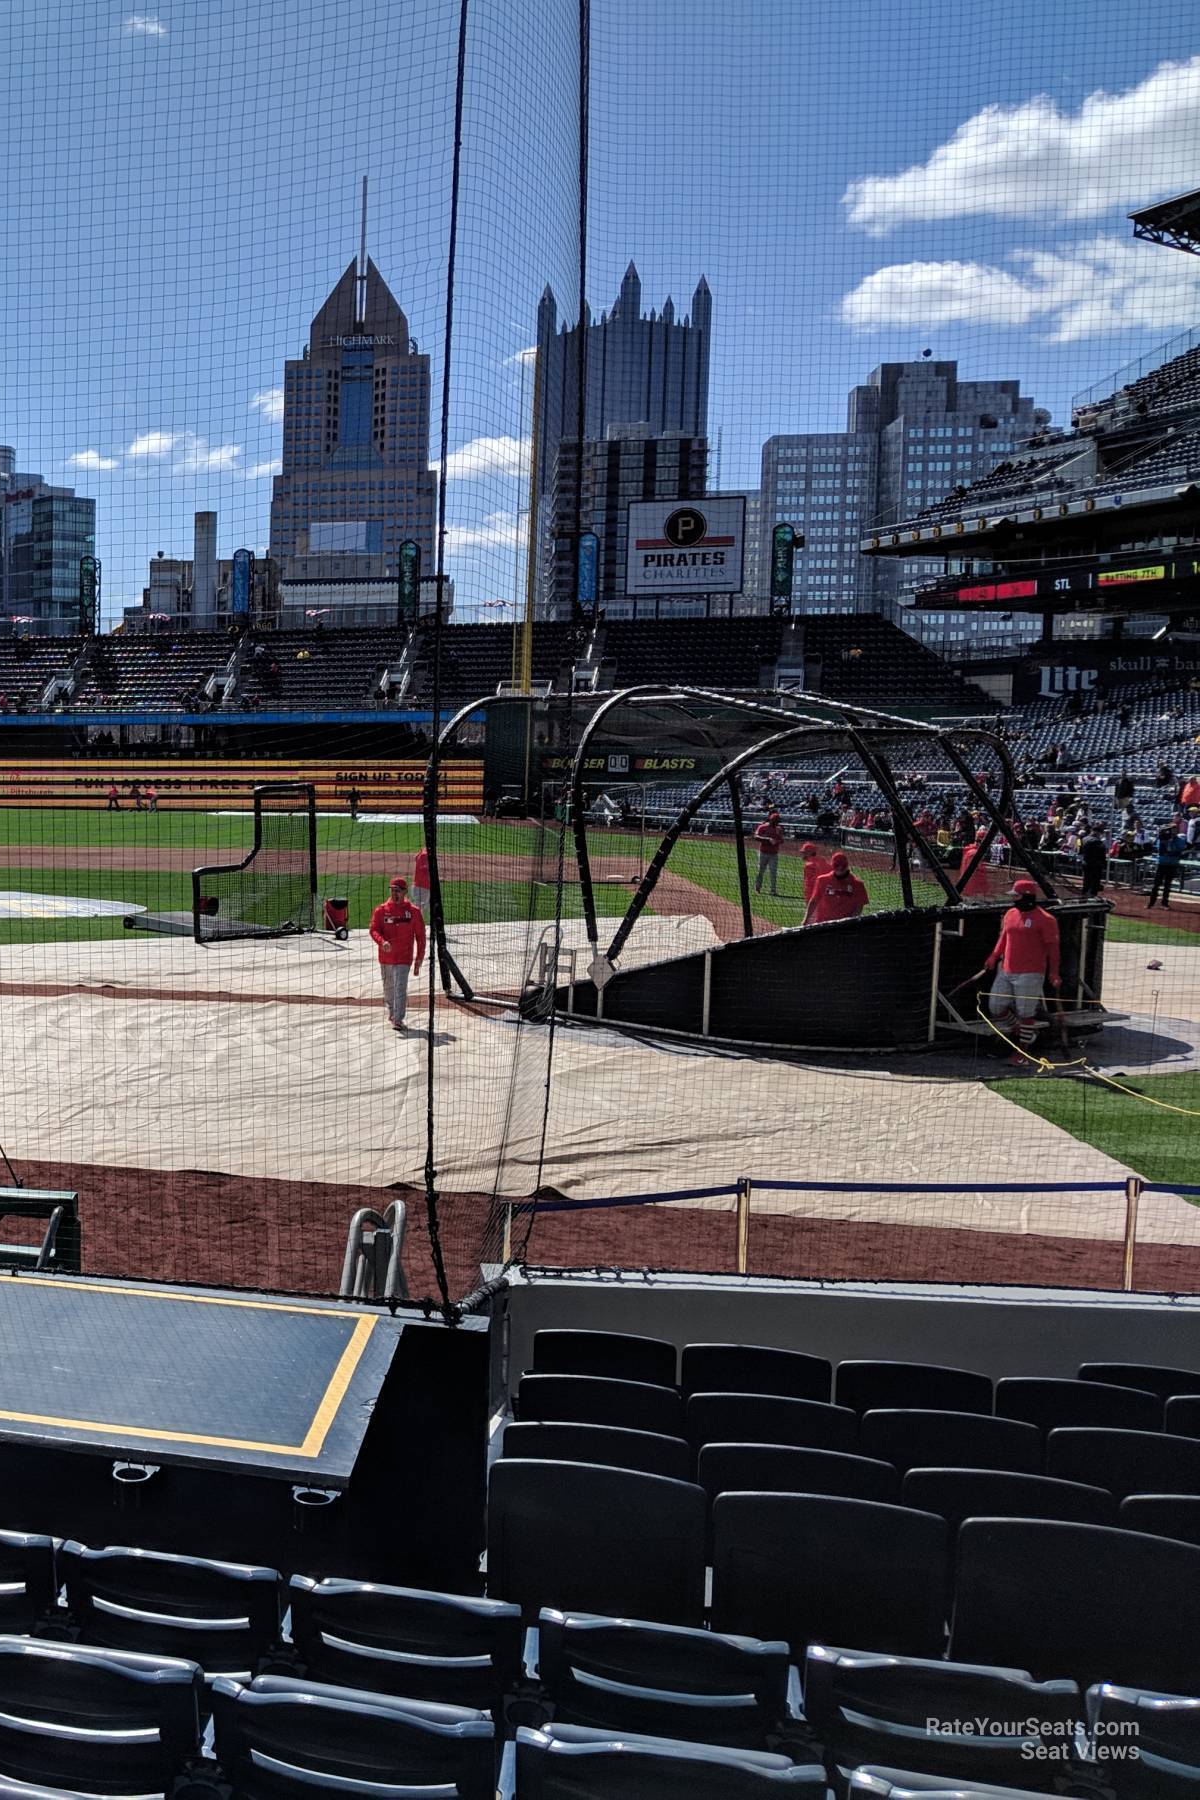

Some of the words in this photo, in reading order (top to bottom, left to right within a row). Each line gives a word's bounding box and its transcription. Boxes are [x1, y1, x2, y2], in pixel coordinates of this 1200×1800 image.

[329, 335, 396, 347] HIGHMARK
[677, 516, 695, 540] P
[643, 551, 726, 568] PIRATES
[643, 567, 726, 580] CHARITIES
[1054, 578, 1071, 590] STL
[1109, 657, 1150, 671] skull
[1038, 666, 1098, 698] Lite
[644, 758, 695, 769] BLASTS
[335, 771, 368, 782] SIGN
[372, 772, 391, 781] UP
[74, 778, 104, 790] FUN
[121, 778, 182, 790] ACCESS
